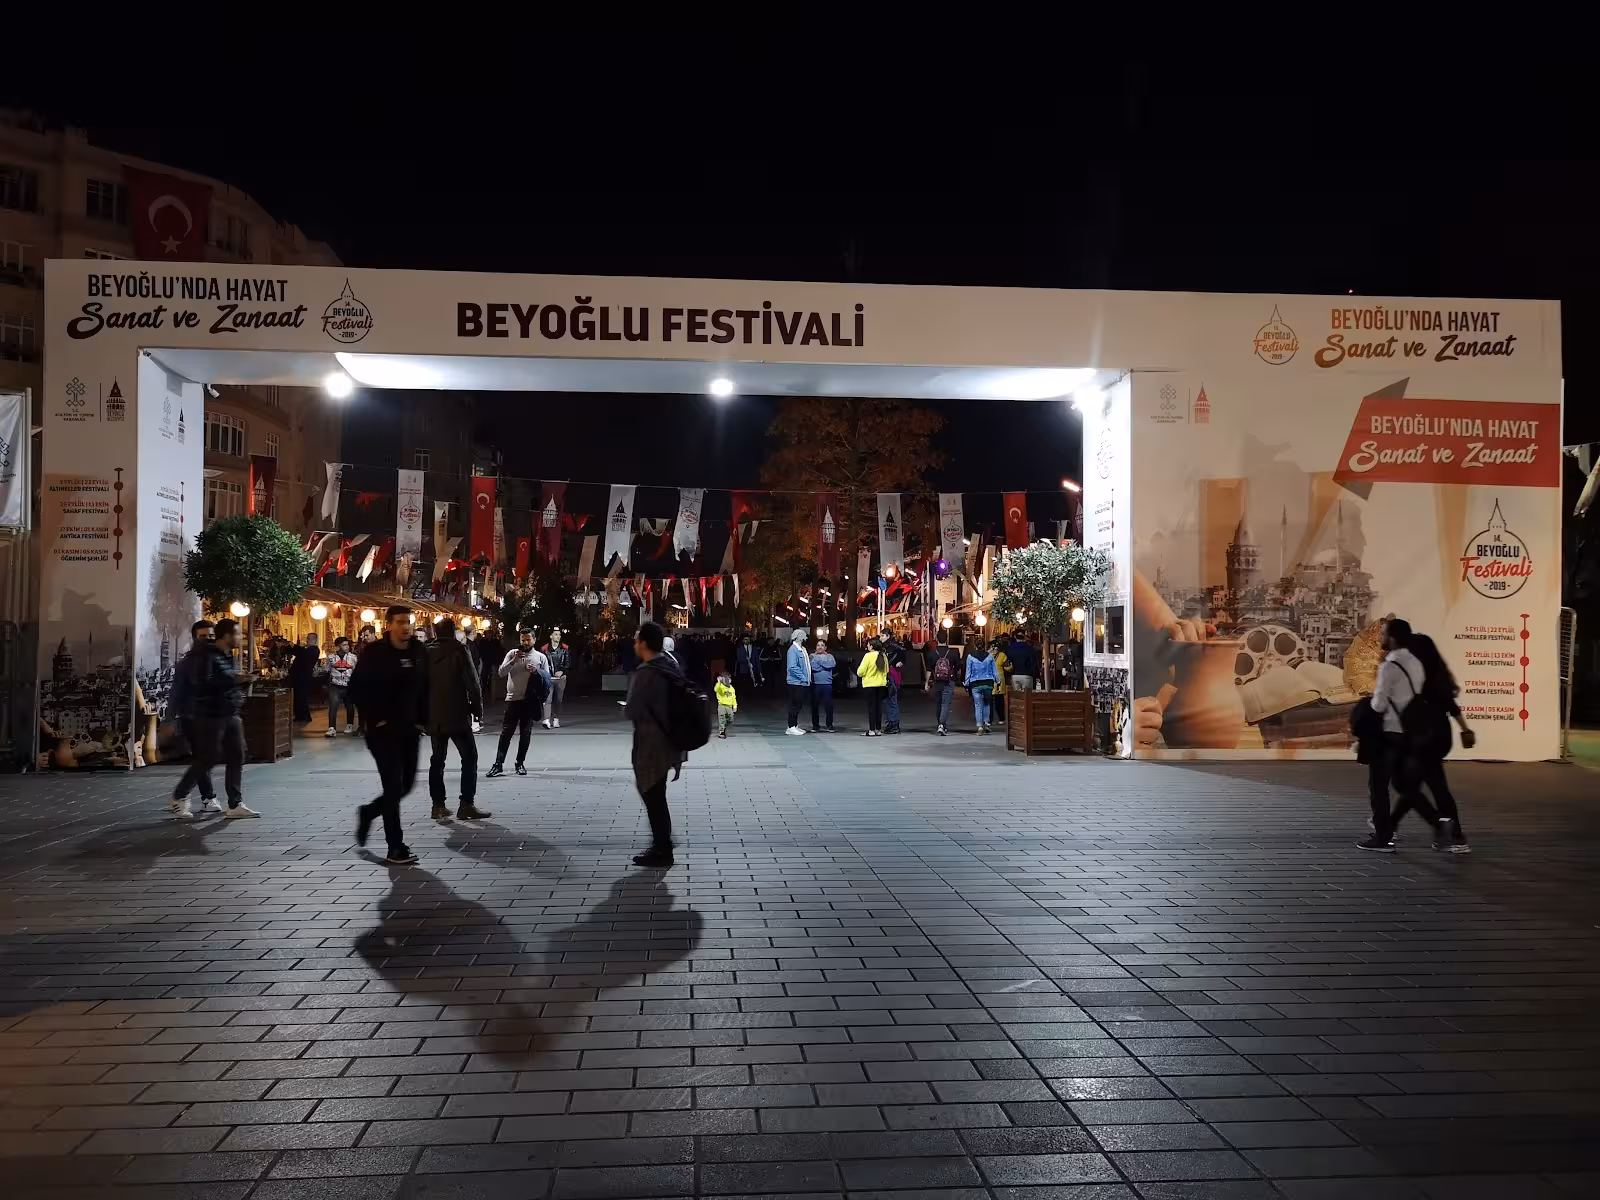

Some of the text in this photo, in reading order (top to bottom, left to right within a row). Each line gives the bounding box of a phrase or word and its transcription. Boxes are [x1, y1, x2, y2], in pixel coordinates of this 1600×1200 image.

[88, 271, 288, 302] BEYOĞLU'NDA HAYAT
[66, 302, 308, 340] Sanat ve Zanaat
[321, 315, 374, 332] Festivali
[333, 307, 364, 316] BEYOĞLU
[457, 296, 864, 346] BEYOĞLU FESTİVALİ
[1332, 306, 1500, 332] BEYOĞLU'NDA HAYAT
[1253, 338, 1300, 354] Festivali
[1264, 331, 1291, 340] BEYOĞLU
[1314, 334, 1517, 368] Sanat ve Zanaat
[1370, 414, 1538, 439] BEYOĞLU'NDA HAYAT
[1348, 440, 1537, 472] Sanat ve Zanaat
[1476, 544, 1520, 558] BEYOĞLU
[1460, 556, 1533, 582] Festivali
[1489, 581, 1506, 590] 2019
